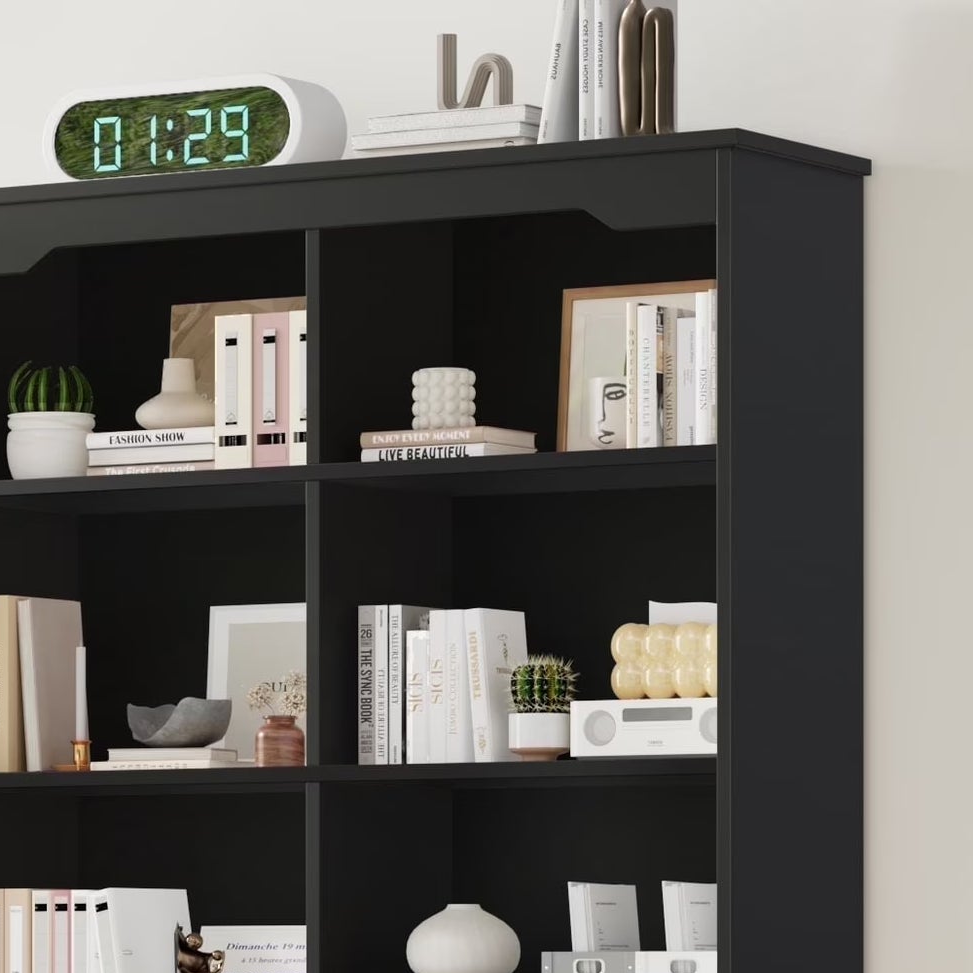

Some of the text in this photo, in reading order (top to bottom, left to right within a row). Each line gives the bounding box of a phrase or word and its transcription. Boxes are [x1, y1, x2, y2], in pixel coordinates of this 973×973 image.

[93, 104, 250, 172] 01:29
[109, 432, 186, 445] FASHION SHOW
[372, 430, 471, 444] ENJOY EVERY MOMENT
[379, 446, 469, 461] LIVE BEAUTIFUL
[360, 629, 372, 639] 26
[361, 650, 372, 667] THE
[469, 631, 482, 699] TRUSSARDI
[391, 662, 398, 671] OF
[361, 670, 372, 695] SYNC
[226, 942, 279, 951] Dimanche
